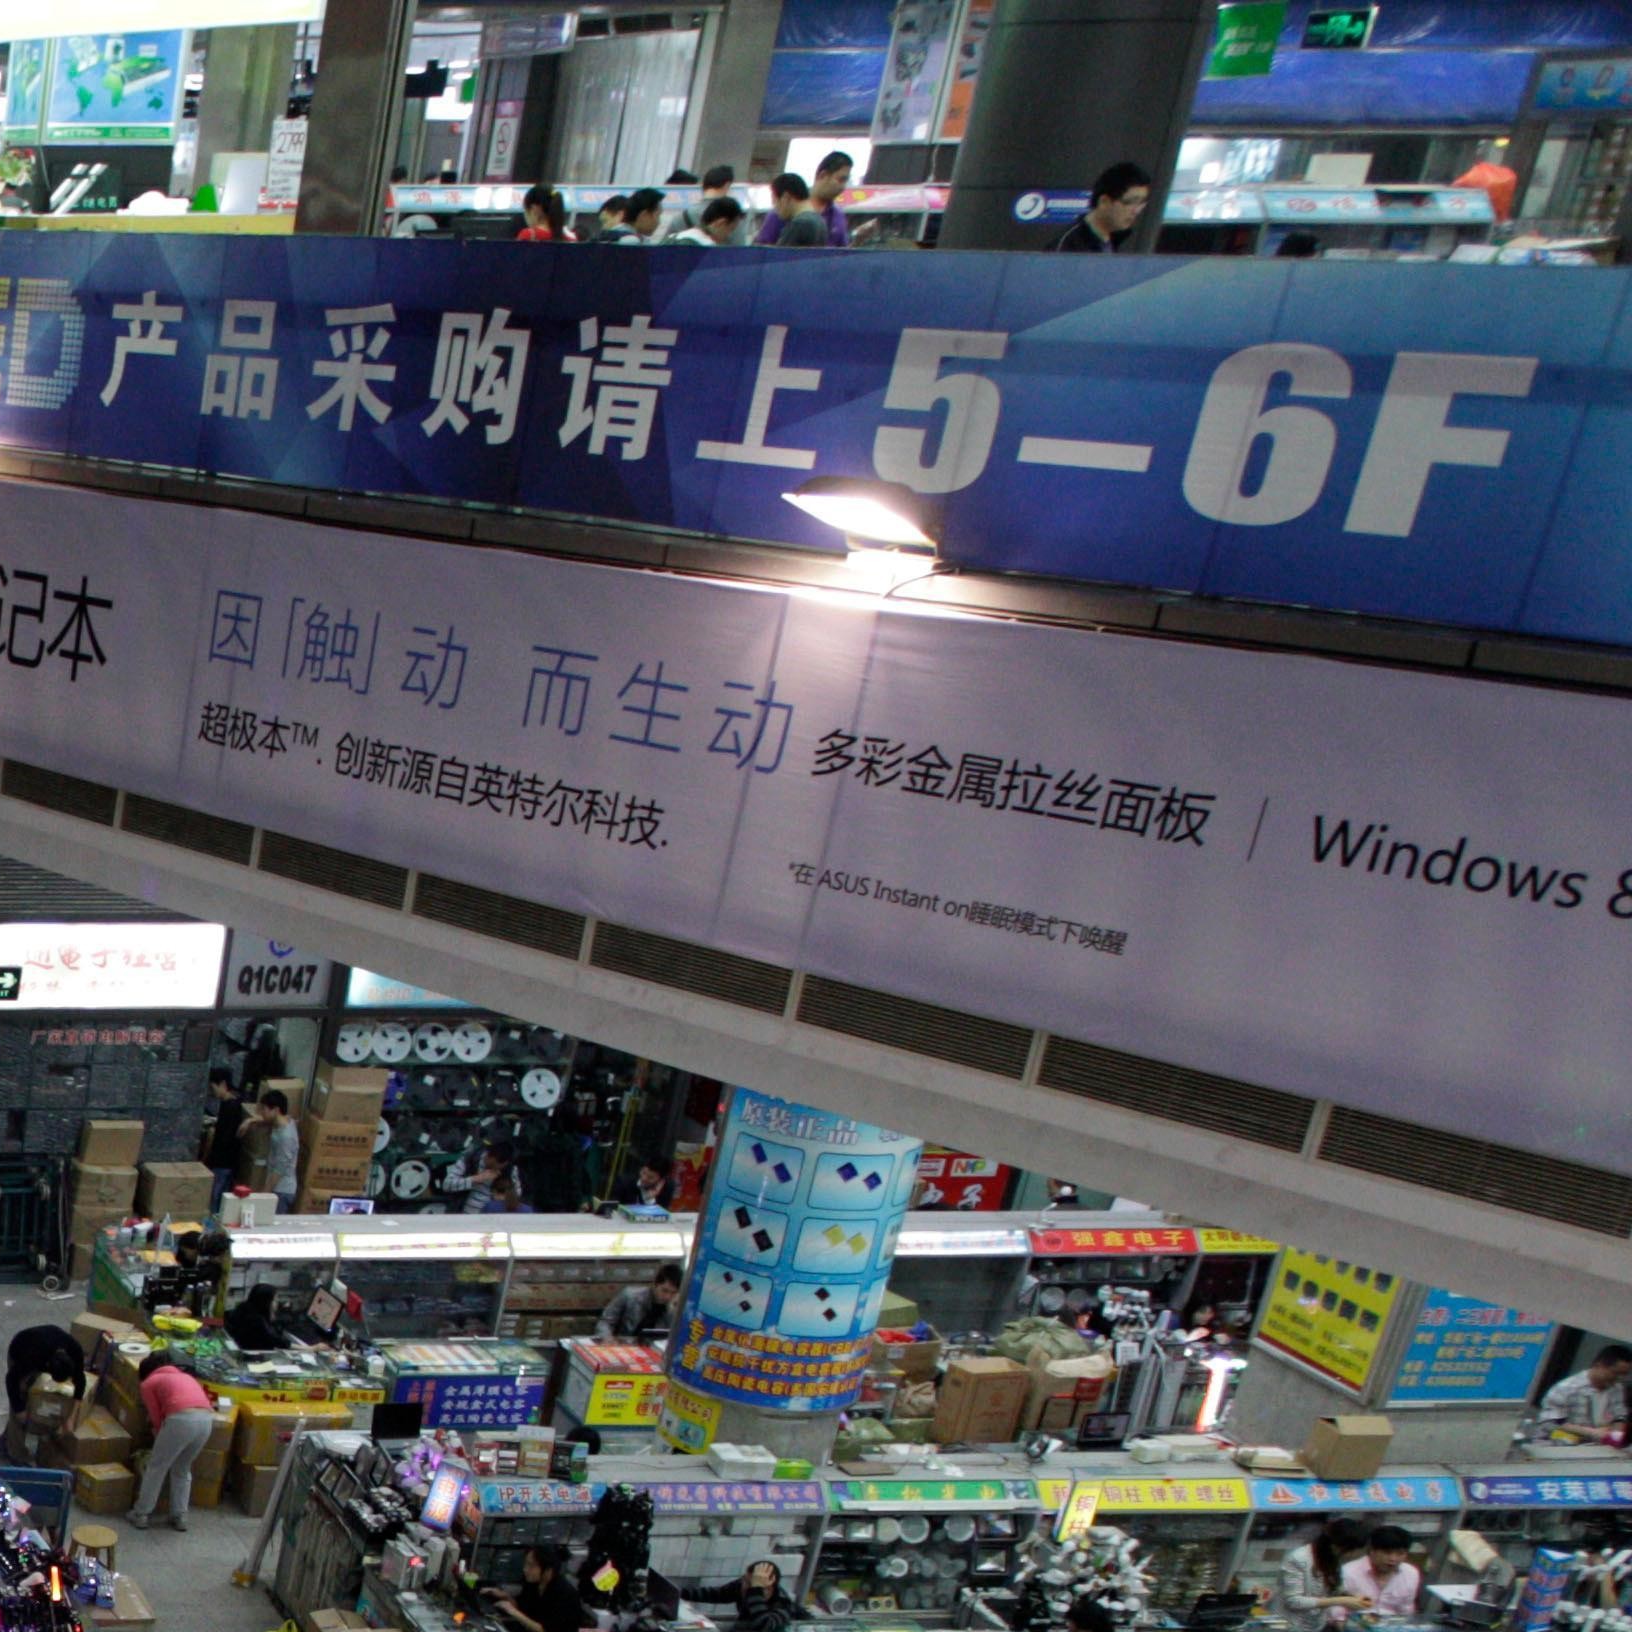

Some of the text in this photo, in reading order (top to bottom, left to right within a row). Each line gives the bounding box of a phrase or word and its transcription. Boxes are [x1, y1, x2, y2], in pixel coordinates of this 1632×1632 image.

[521, 644, 796, 777] 而生动
[810, 727, 1217, 849] 多彩金属拉丝面板
[1311, 813, 1588, 909] Windows
[817, 869, 869, 899] ASUS
[874, 880, 939, 913] Instant
[944, 898, 1131, 958] on睡眠模式下唤醒
[238, 964, 317, 994] Q1C047
[1071, 1230, 1186, 1247] 强鑫电子
